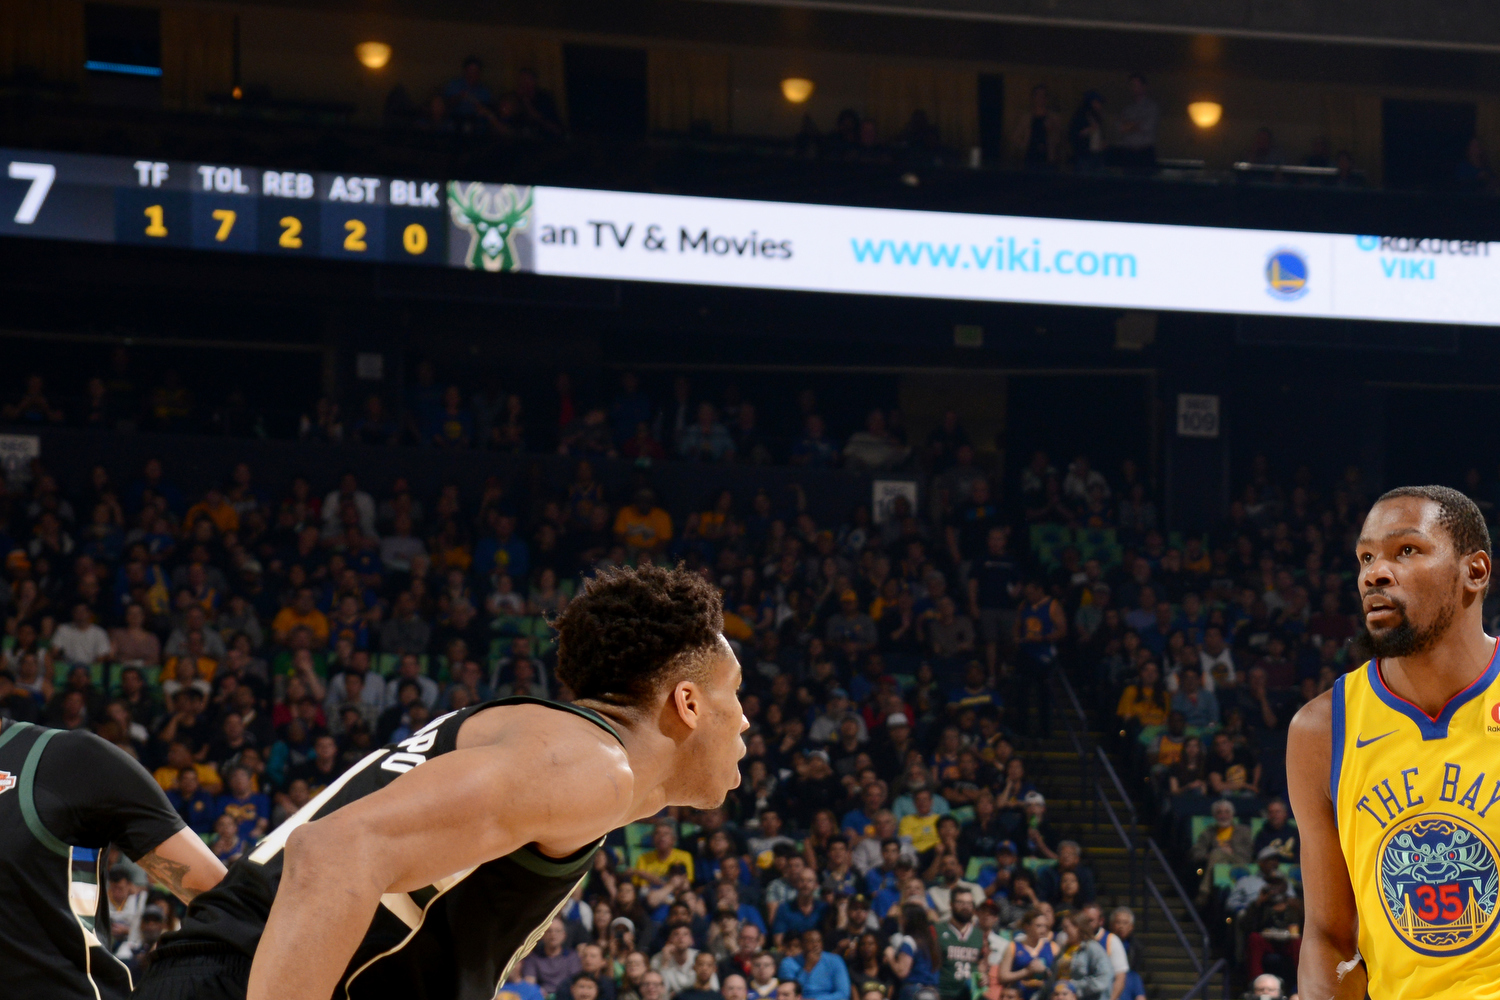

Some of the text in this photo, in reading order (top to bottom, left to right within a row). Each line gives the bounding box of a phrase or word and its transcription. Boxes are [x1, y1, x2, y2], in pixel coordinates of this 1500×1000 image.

[8, 161, 57, 225] 7
[134, 160, 440, 208] TF TOL REB AST BLK
[143, 204, 429, 256] 1 7 2 2 0
[587, 220, 634, 249] TV
[643, 223, 667, 252] &
[679, 226, 794, 260] Movies
[850, 236, 1138, 279] www.viki.com
[1380, 257, 1436, 280] VIKI
[1182, 412, 1216, 431] 109
[1356, 767, 1424, 829] THE
[1414, 883, 1464, 921] 35
